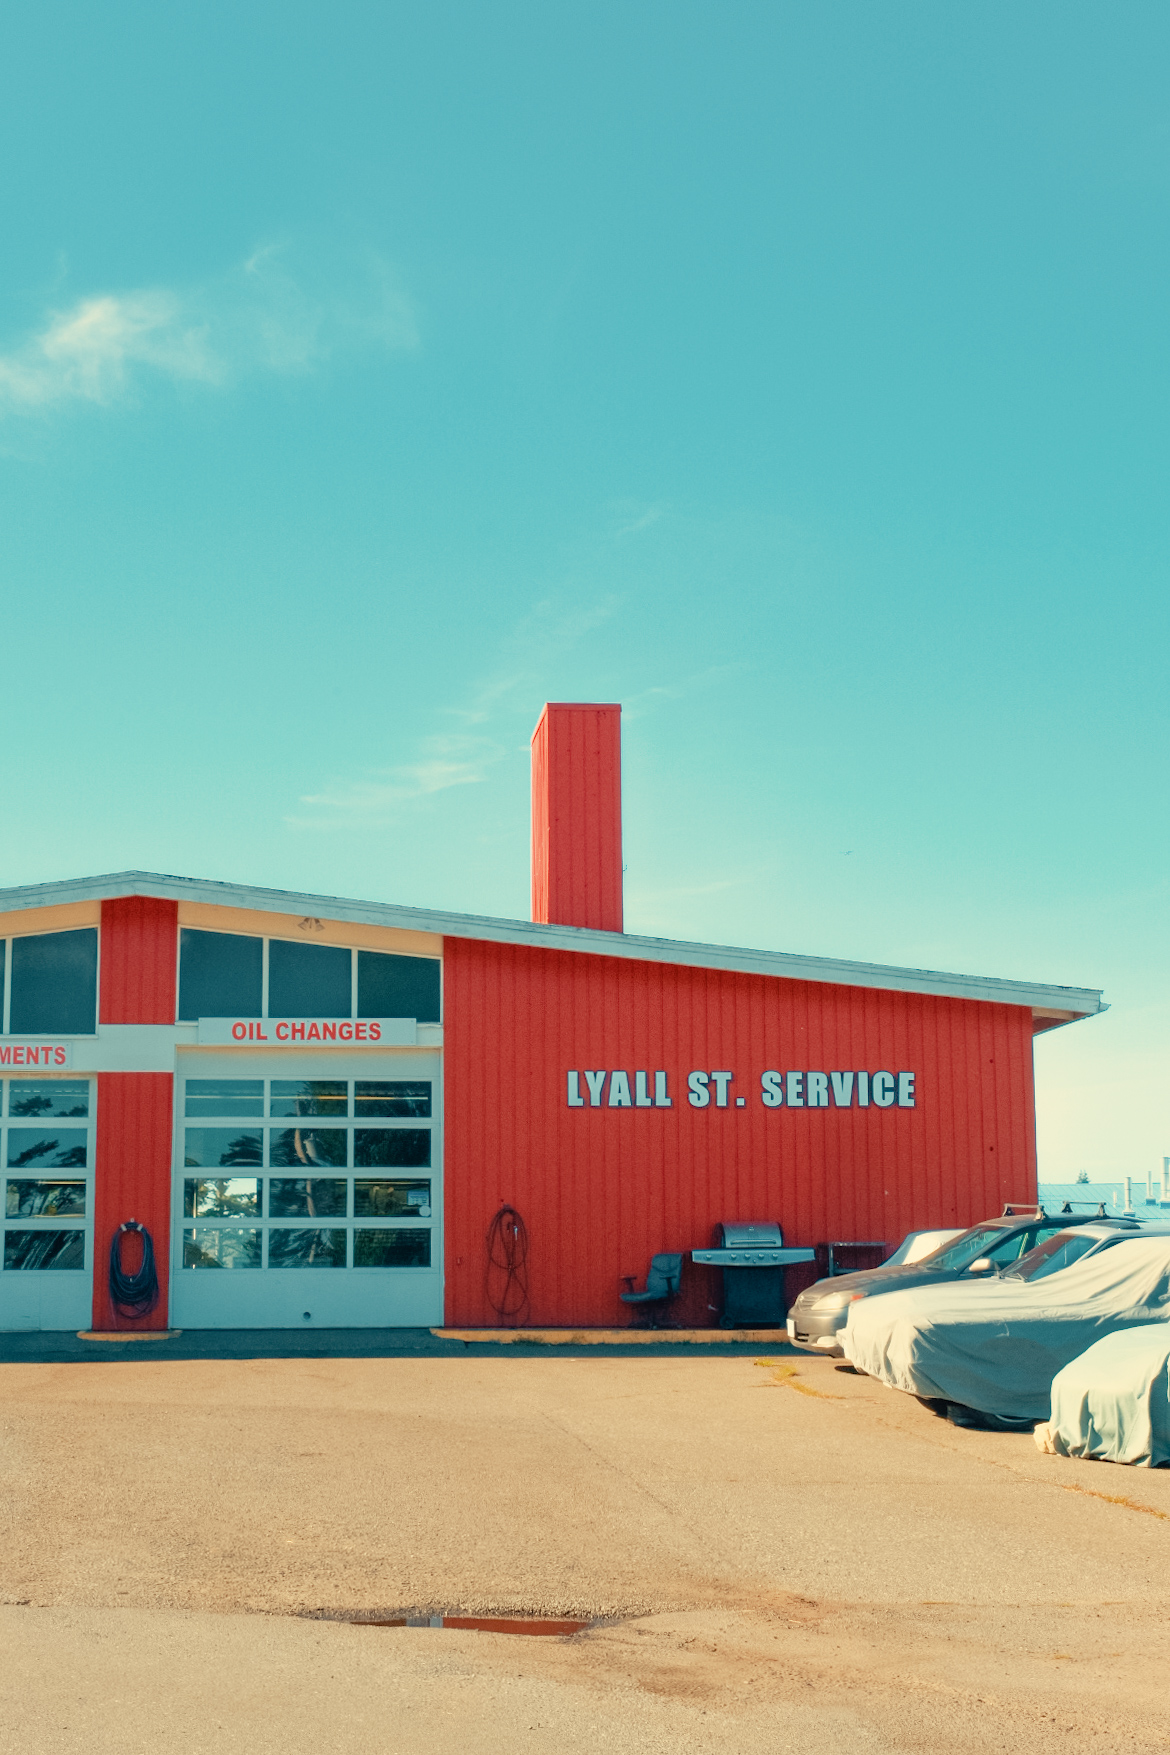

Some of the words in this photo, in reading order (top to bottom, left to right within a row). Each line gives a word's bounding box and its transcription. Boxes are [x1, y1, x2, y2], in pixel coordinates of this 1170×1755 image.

[231, 1021, 268, 1041] OIL
[275, 1021, 382, 1041] CHANGES
[0, 1046, 66, 1065] MENTS
[567, 1071, 672, 1107] LYALL
[687, 1071, 745, 1108] ST.
[760, 1071, 916, 1108] SERVICE
